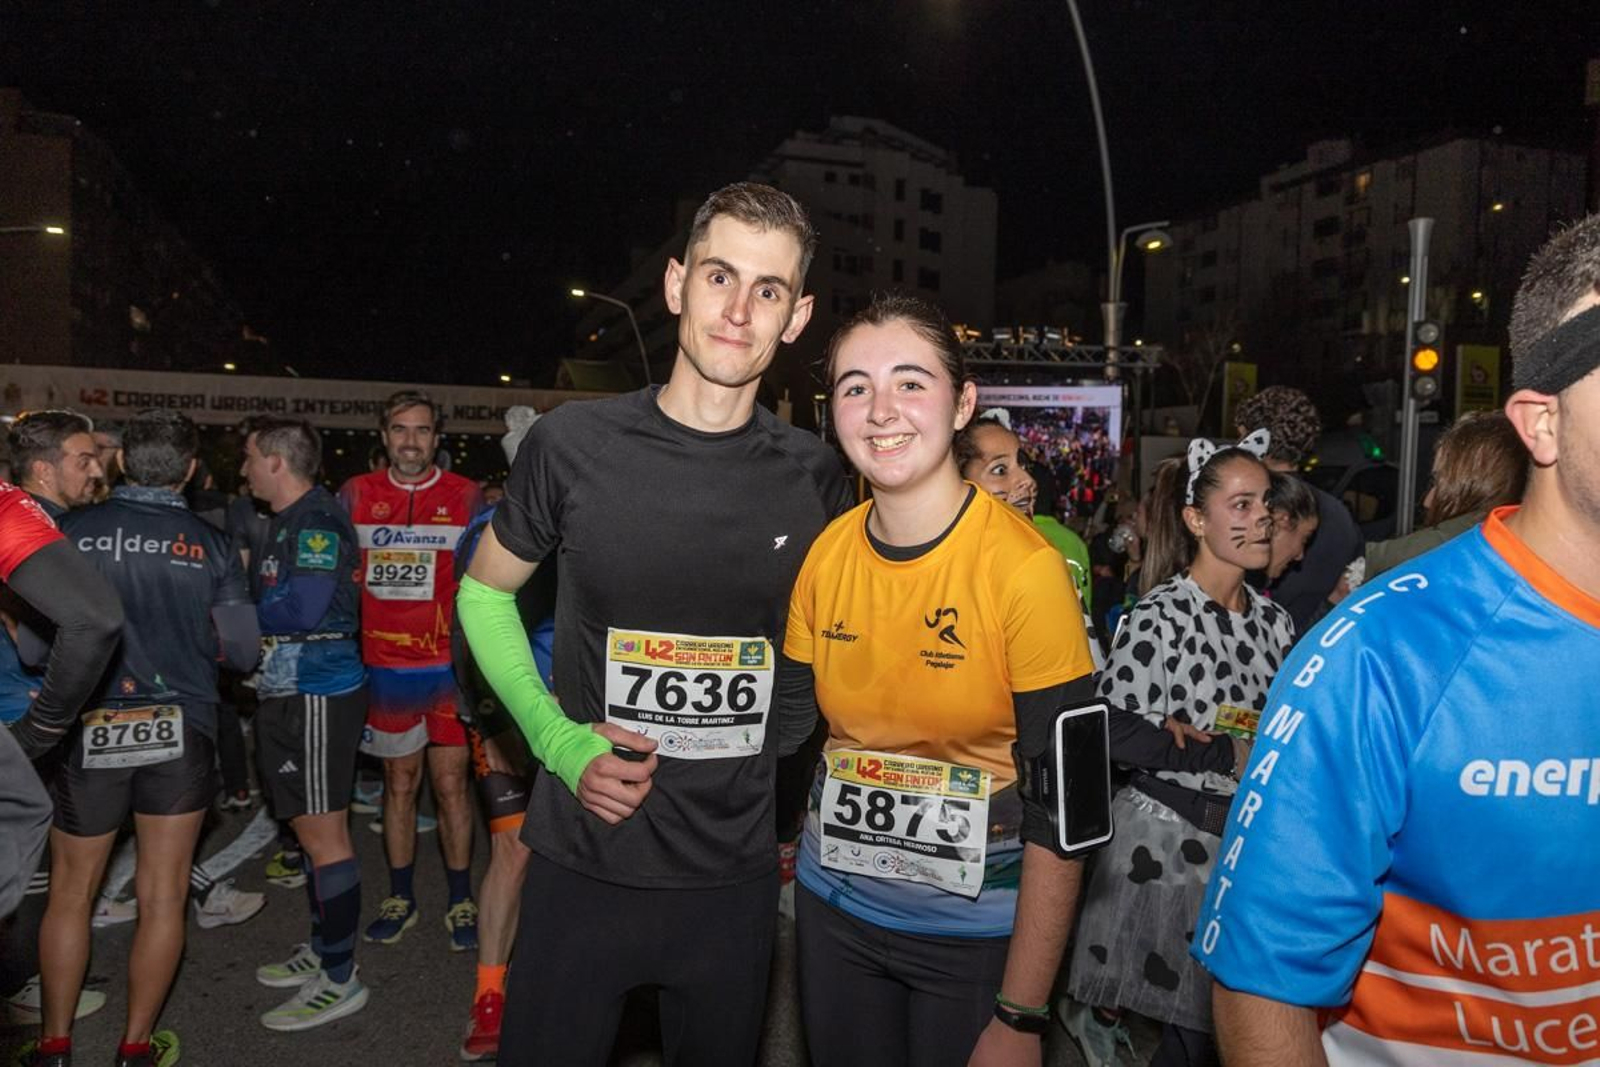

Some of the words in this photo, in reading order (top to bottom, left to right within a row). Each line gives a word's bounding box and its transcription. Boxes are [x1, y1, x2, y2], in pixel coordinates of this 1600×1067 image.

[79, 388, 108, 406] 42
[113, 389, 205, 410] CARRERA
[211, 394, 287, 413] URBANA
[78, 527, 204, 561] calderón
[393, 531, 447, 544] Avanza
[373, 565, 427, 581] 9929
[1293, 572, 1429, 688] CLUB
[645, 639, 674, 661] 42
[675, 652, 696, 661] SAN
[698, 652, 734, 662] ANTON
[622, 665, 757, 713] 7636
[638, 713, 653, 721] LUIS
[654, 714, 663, 722] DE
[677, 717, 699, 725] TORRE
[701, 716, 736, 725] MARTINEZ
[91, 720, 174, 747] 8768
[857, 757, 882, 781] 42
[883, 771, 904, 782] SAN
[834, 784, 971, 844] 5875
[1203, 703, 1306, 955] MARATÓ
[859, 833, 874, 842] ANA
[875, 835, 901, 846] ORTEGA
[902, 840, 937, 853] HERMOSO
[1430, 922, 1600, 977] Marat
[1454, 1001, 1598, 1055] Luce
